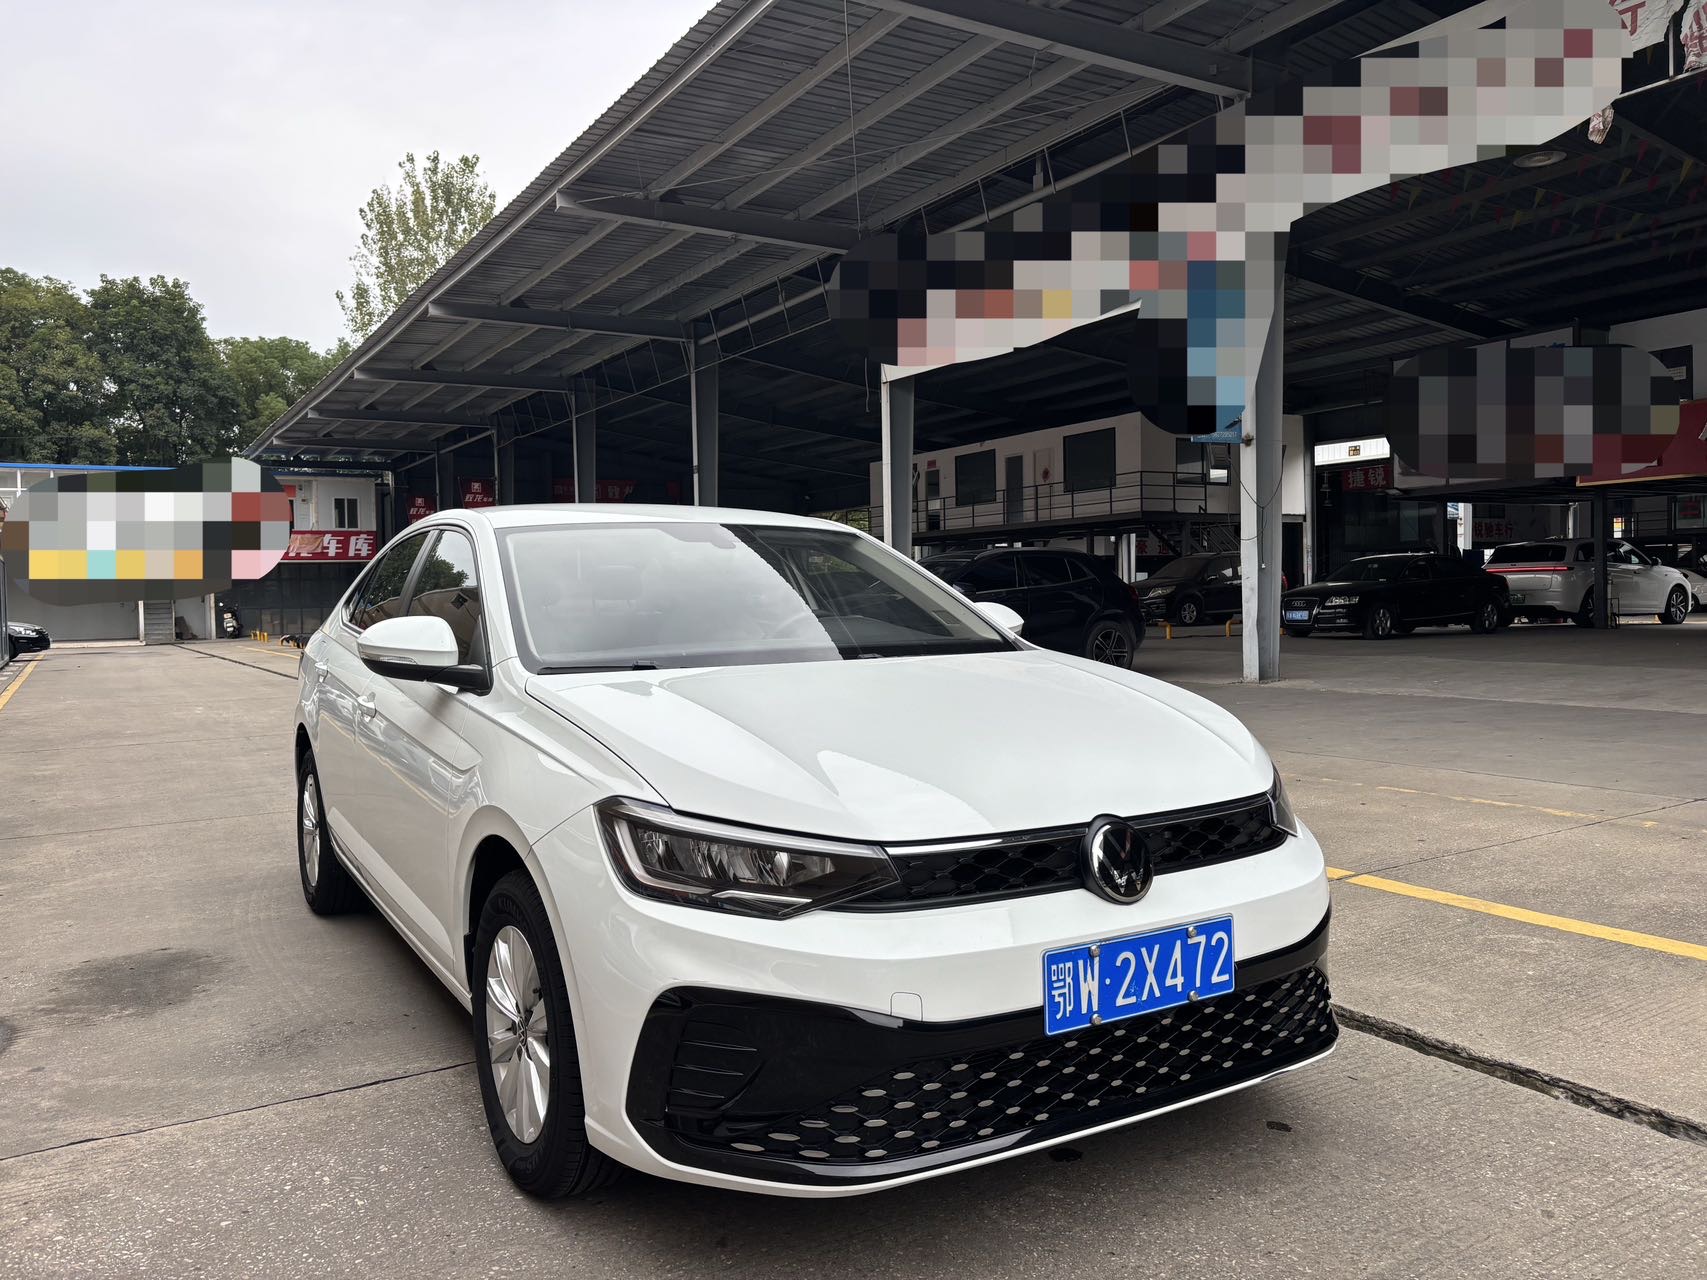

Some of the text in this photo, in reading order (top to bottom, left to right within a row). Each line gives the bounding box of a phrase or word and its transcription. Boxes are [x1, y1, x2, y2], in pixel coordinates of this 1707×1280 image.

[1347, 467, 1386, 488] 捷锐
[288, 534, 374, 557] 车库
[1051, 931, 1230, 1020] 鄂W·2X472
